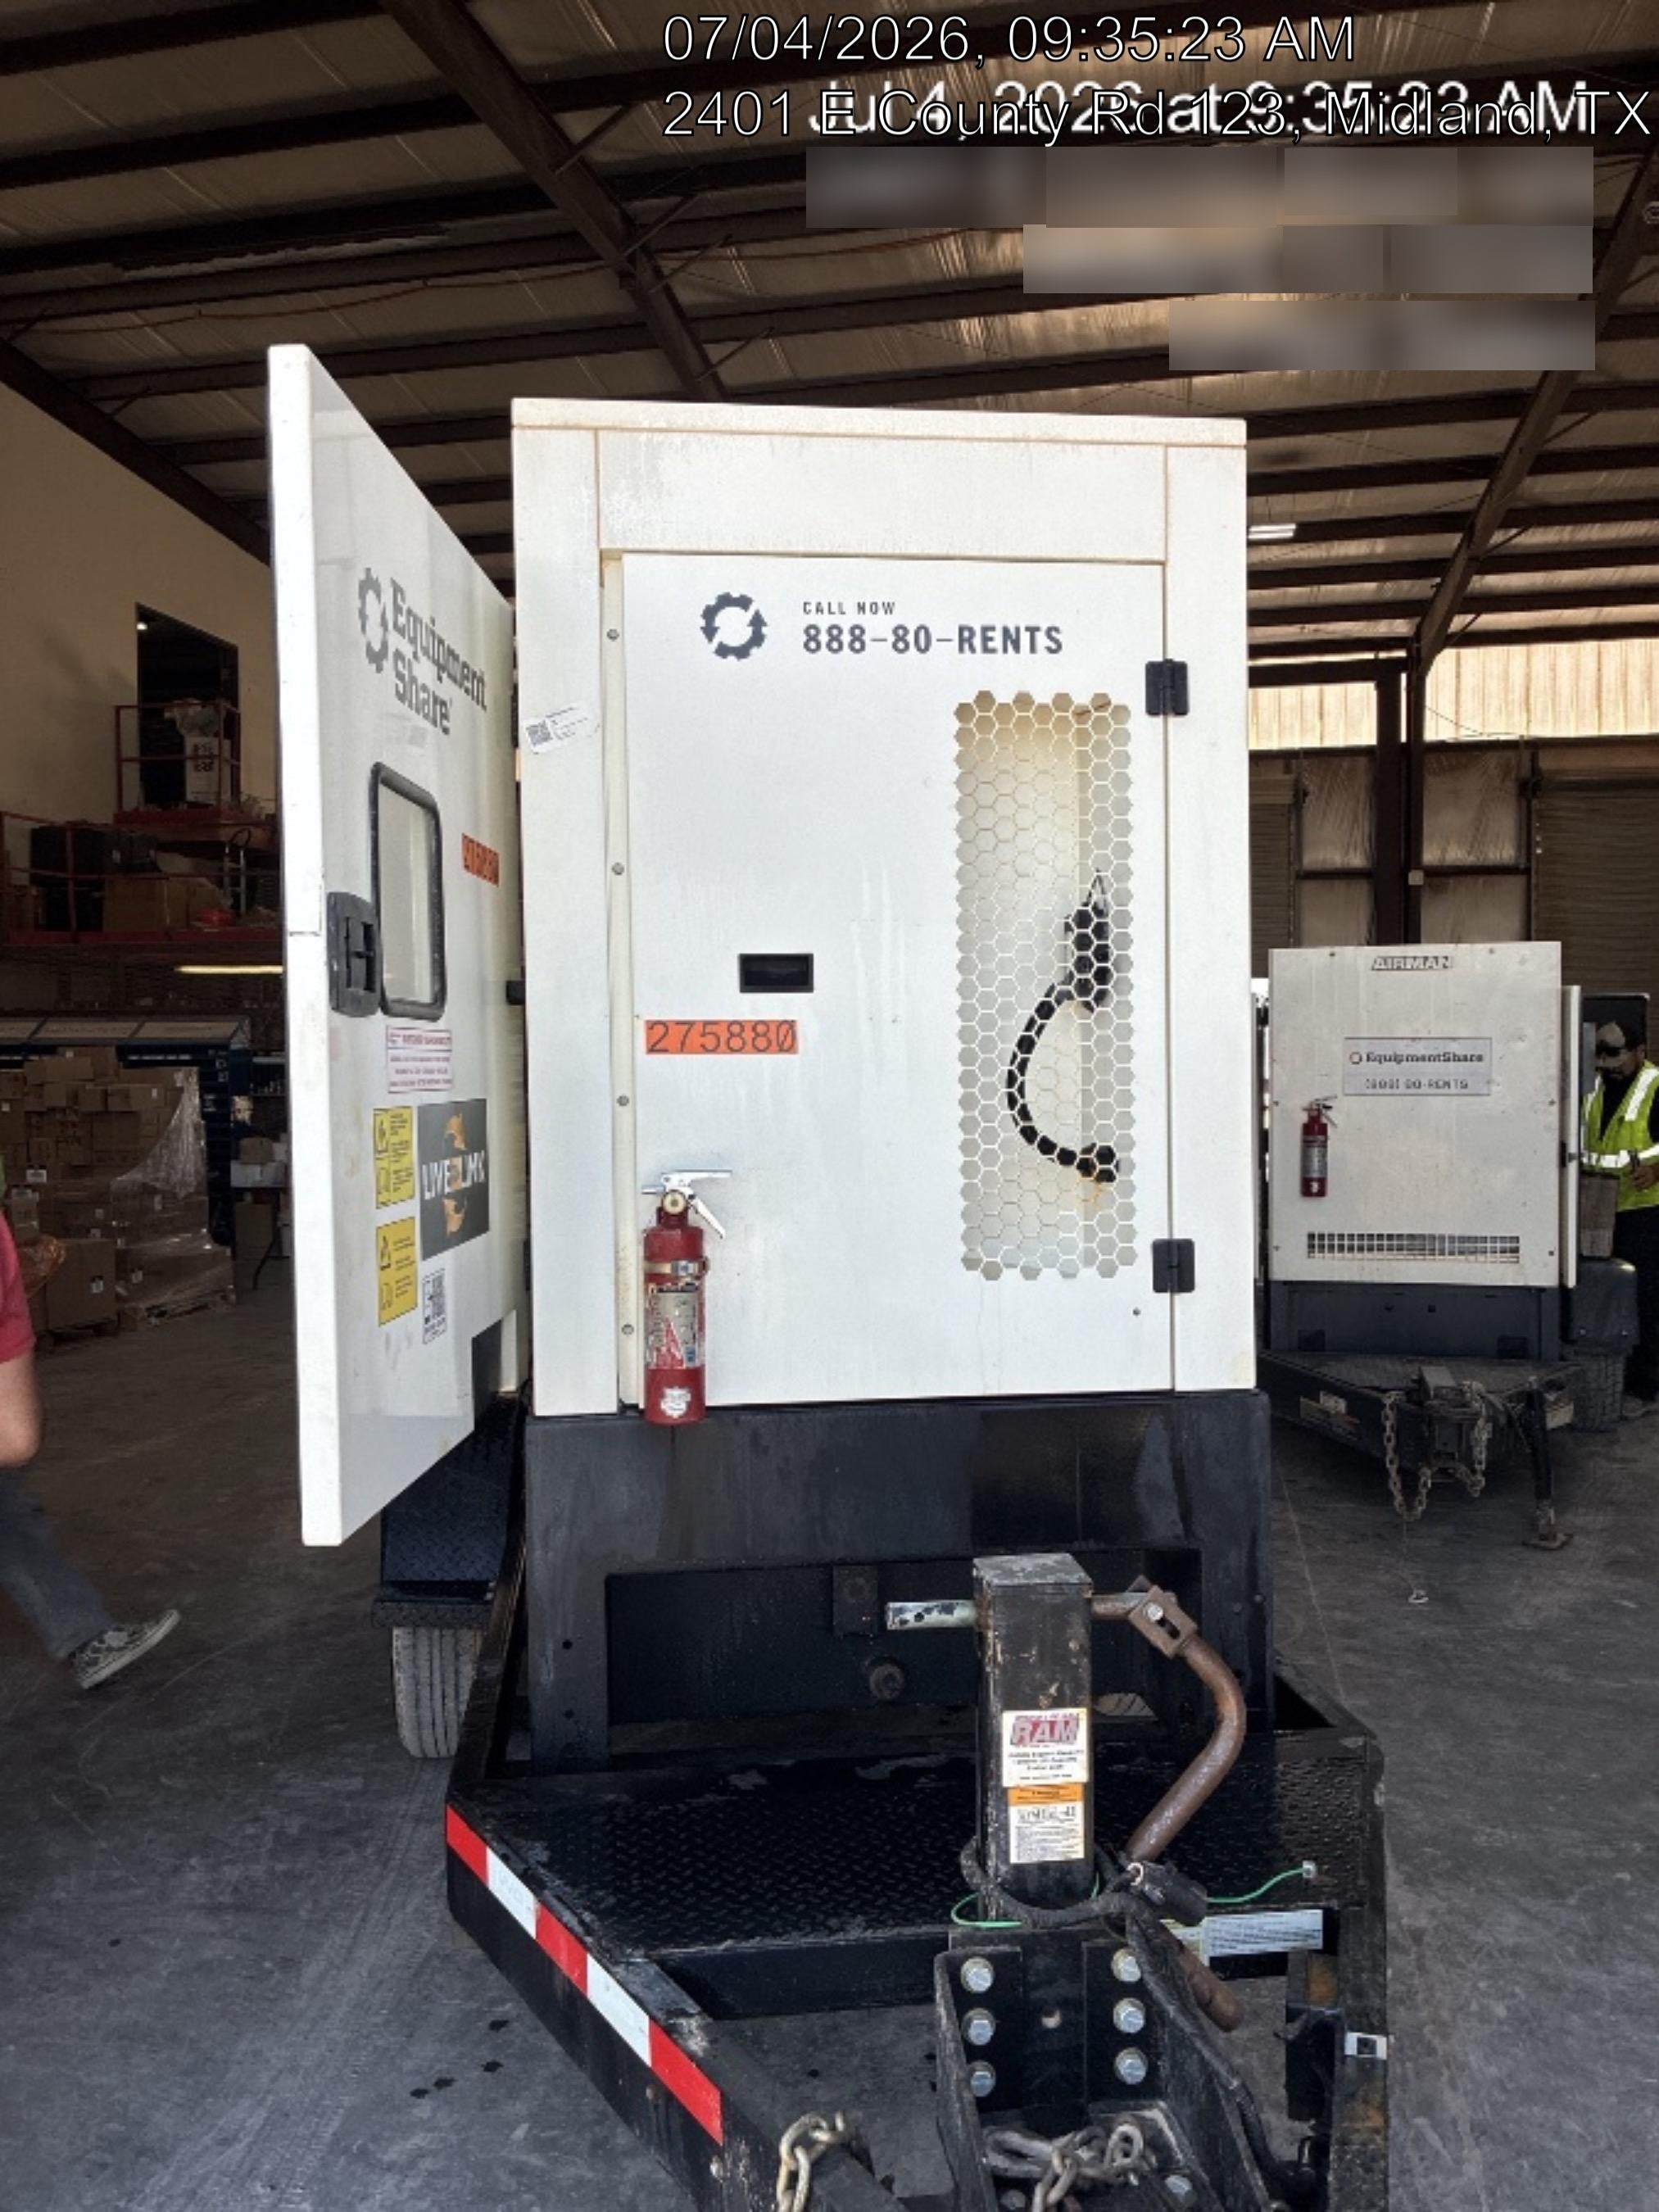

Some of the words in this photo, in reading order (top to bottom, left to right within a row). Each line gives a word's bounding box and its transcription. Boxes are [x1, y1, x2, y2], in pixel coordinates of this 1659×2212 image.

[803, 601, 847, 615] CALL
[857, 601, 895, 615] NOW
[390, 577, 487, 713] Equipment
[802, 623, 1063, 655] 888-80-RENTS
[392, 648, 451, 736] Share
[648, 1020, 797, 1054] 275880
